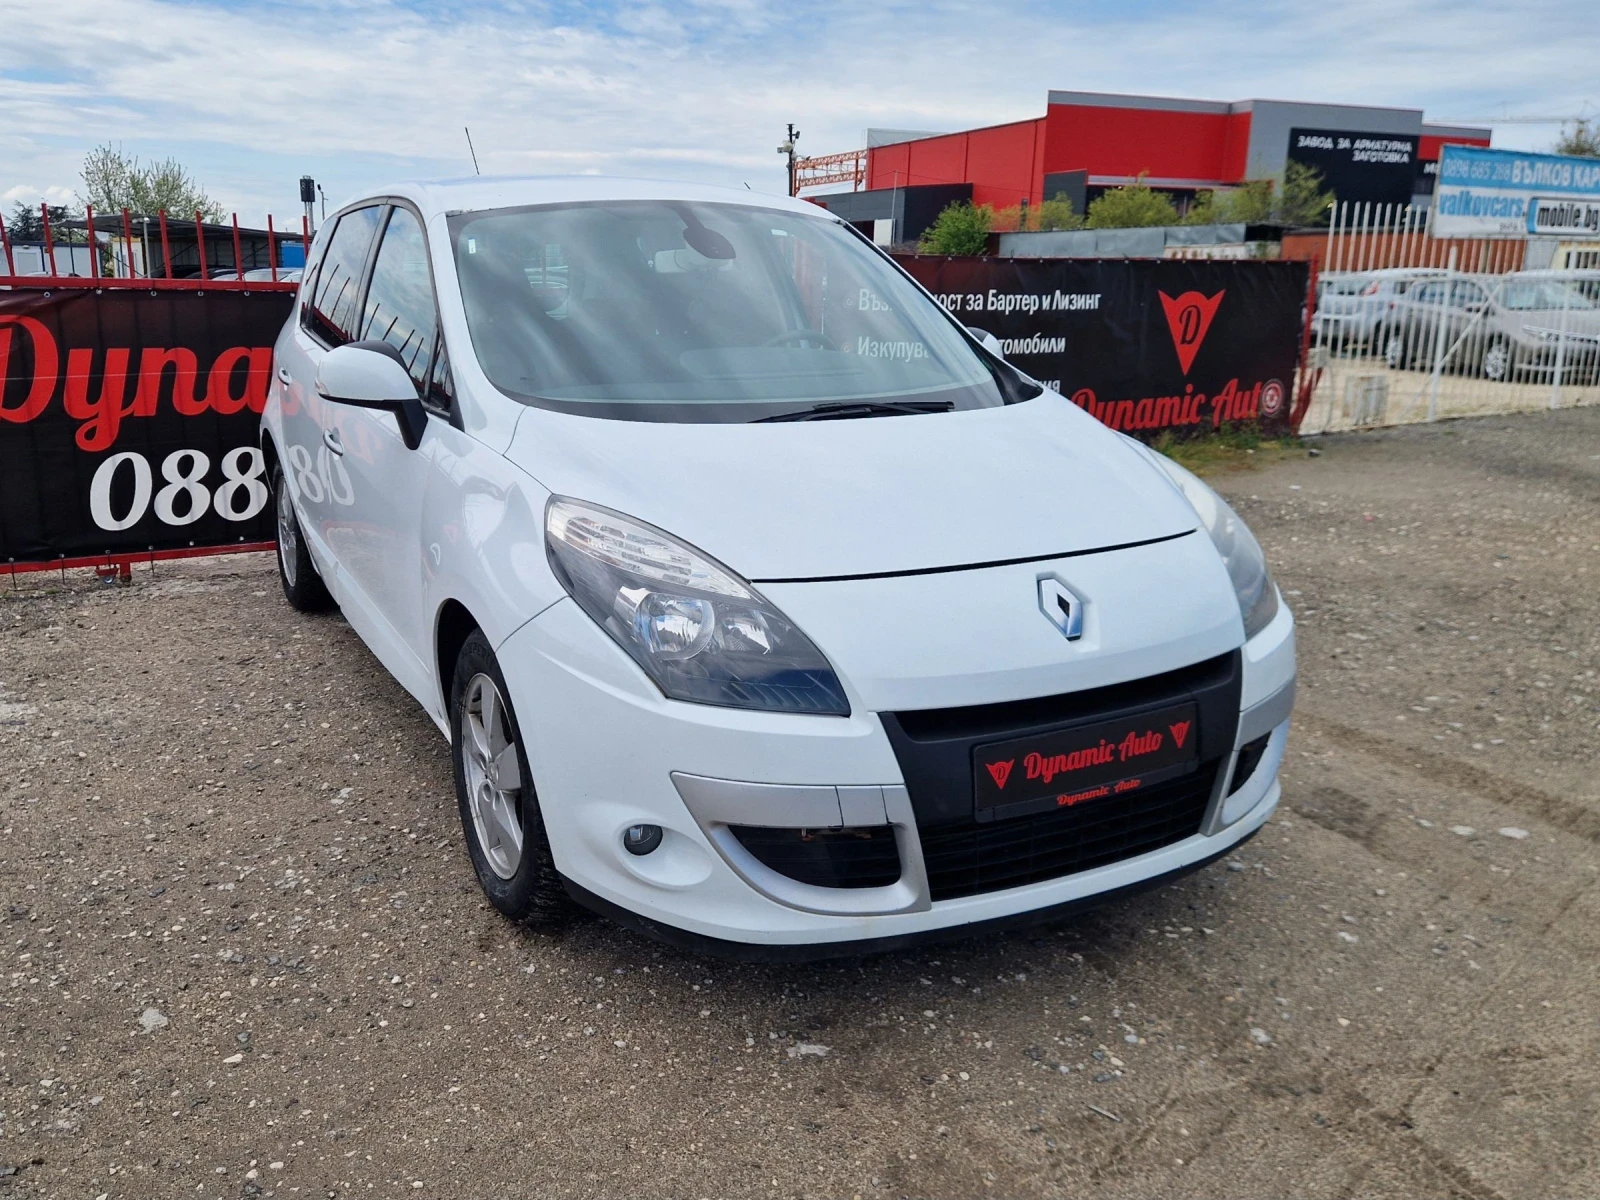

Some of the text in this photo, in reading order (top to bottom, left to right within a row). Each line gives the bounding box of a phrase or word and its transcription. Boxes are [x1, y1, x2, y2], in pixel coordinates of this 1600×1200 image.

[1337, 138, 1351, 150] ЗА
[1511, 159, 1572, 186] ВЪЛКОВ
[966, 293, 984, 311] за
[986, 288, 1039, 315] Бартер
[1041, 295, 1051, 311] и
[1052, 289, 1102, 311] Лизинг
[1070, 383, 1206, 431] Dynamic
[1023, 728, 1163, 784] Dynamic Auto
[1056, 779, 1141, 806] Dynamic Auto
